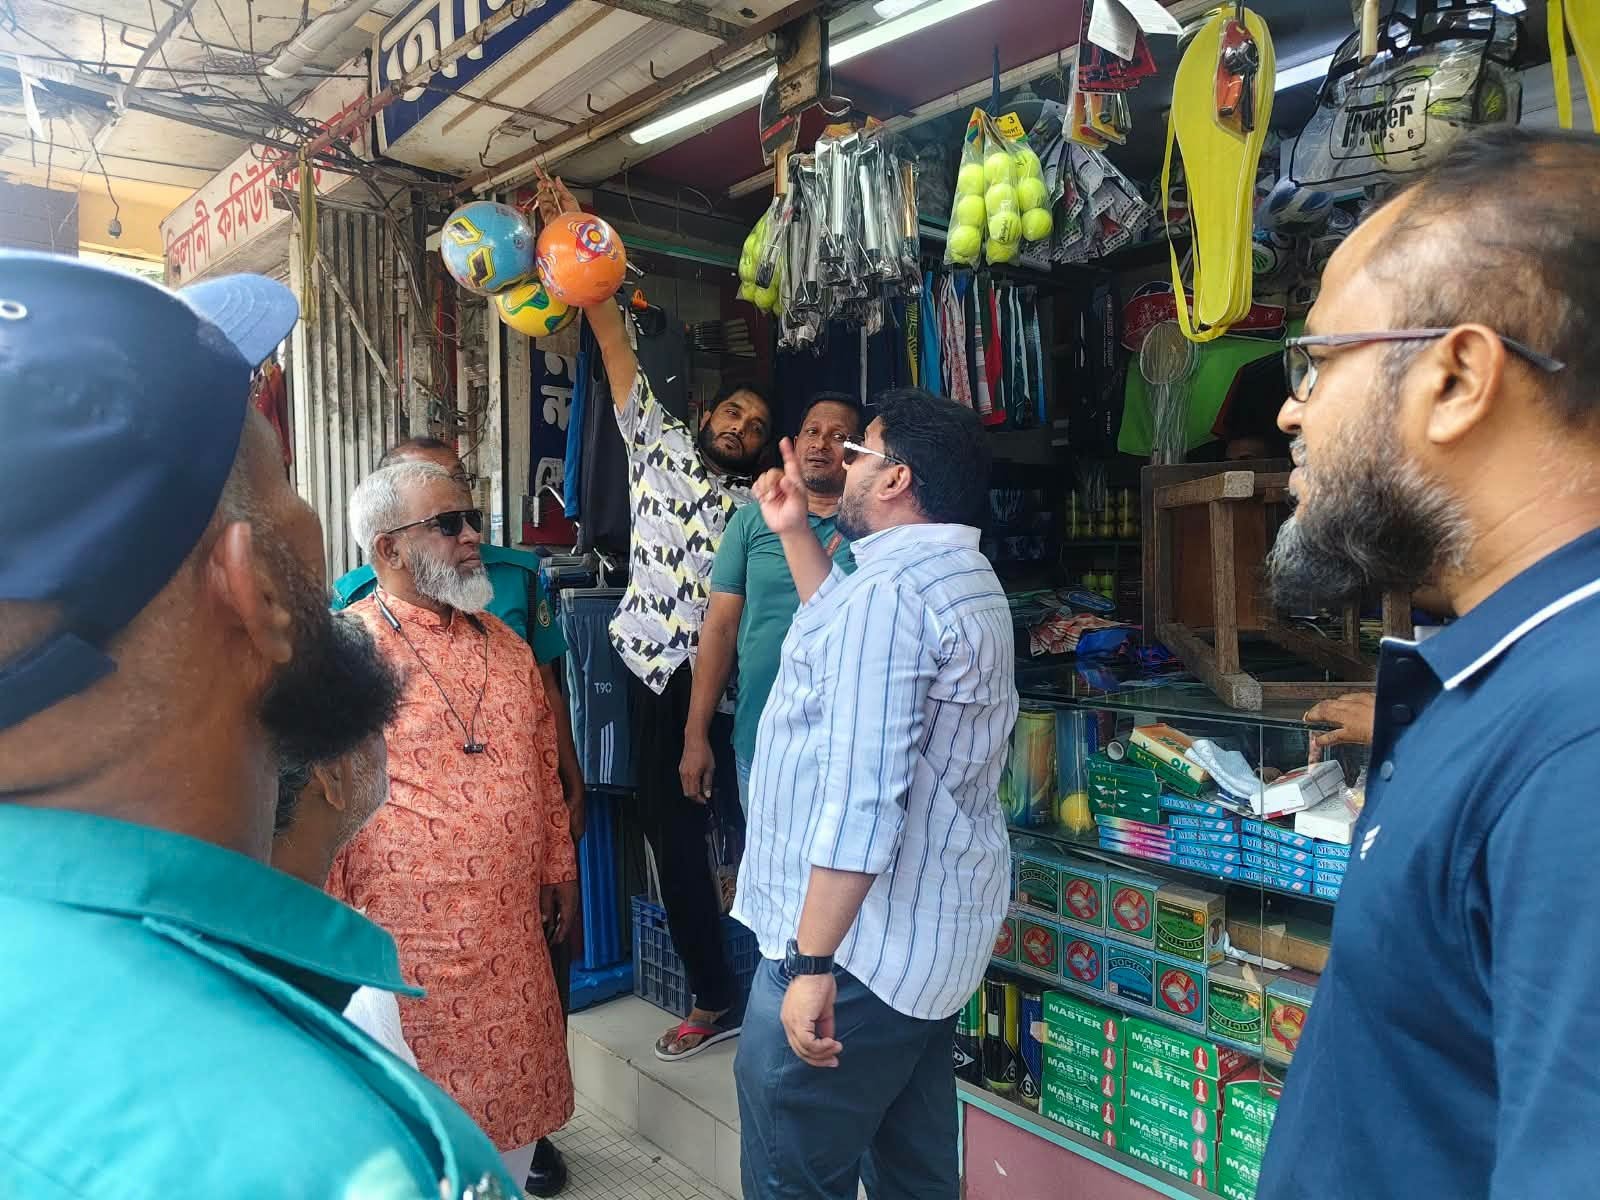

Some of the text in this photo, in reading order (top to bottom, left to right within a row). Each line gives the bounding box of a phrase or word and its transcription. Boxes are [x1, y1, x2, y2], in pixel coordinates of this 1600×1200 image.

[1171, 757, 1191, 773] OK
[1048, 1003, 1102, 1030] MASTER
[1047, 1029, 1100, 1057] MASTER
[1131, 1031, 1191, 1059] MASTER
[1132, 1060, 1190, 1090] MASTER
[1047, 1083, 1100, 1113] MASTER
[1129, 1088, 1190, 1120] MASTER
[1231, 1096, 1276, 1121] MAST
[1048, 1110, 1101, 1141] MASTER
[1129, 1117, 1190, 1150] MASTER
[1230, 1127, 1266, 1150] MAS
[1129, 1145, 1190, 1180] MASTER
[1225, 1156, 1260, 1178] MAS
